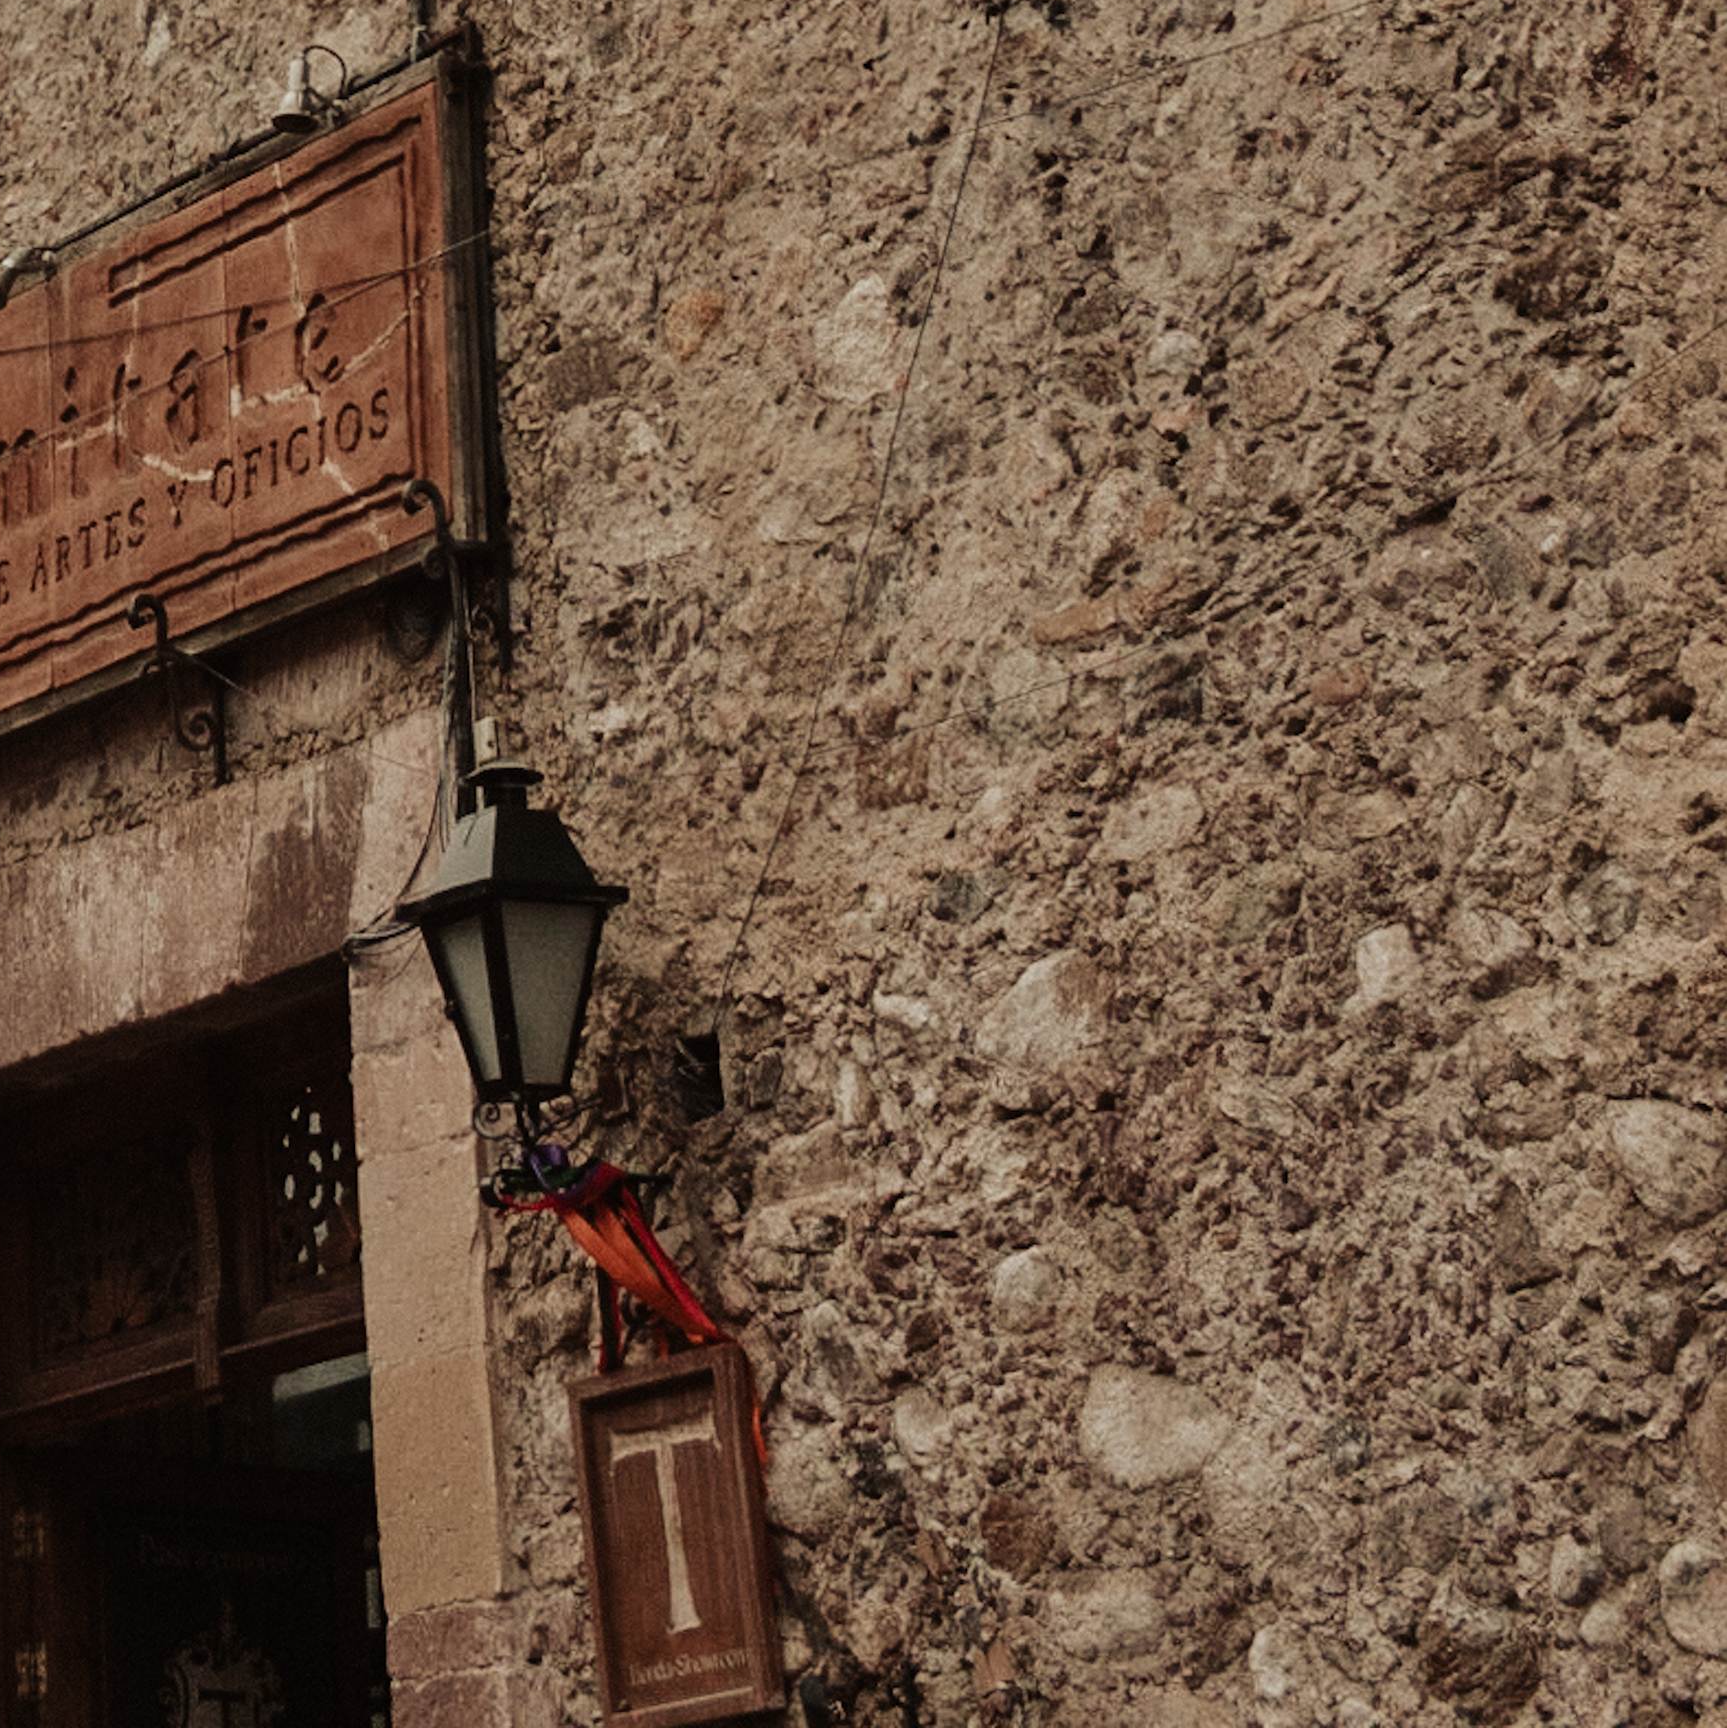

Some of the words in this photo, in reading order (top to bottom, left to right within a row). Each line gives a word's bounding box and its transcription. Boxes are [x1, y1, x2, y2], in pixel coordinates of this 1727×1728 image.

[30, 496, 146, 593] ARTES
[167, 478, 188, 529] Y
[211, 387, 389, 509] OFICIOS
